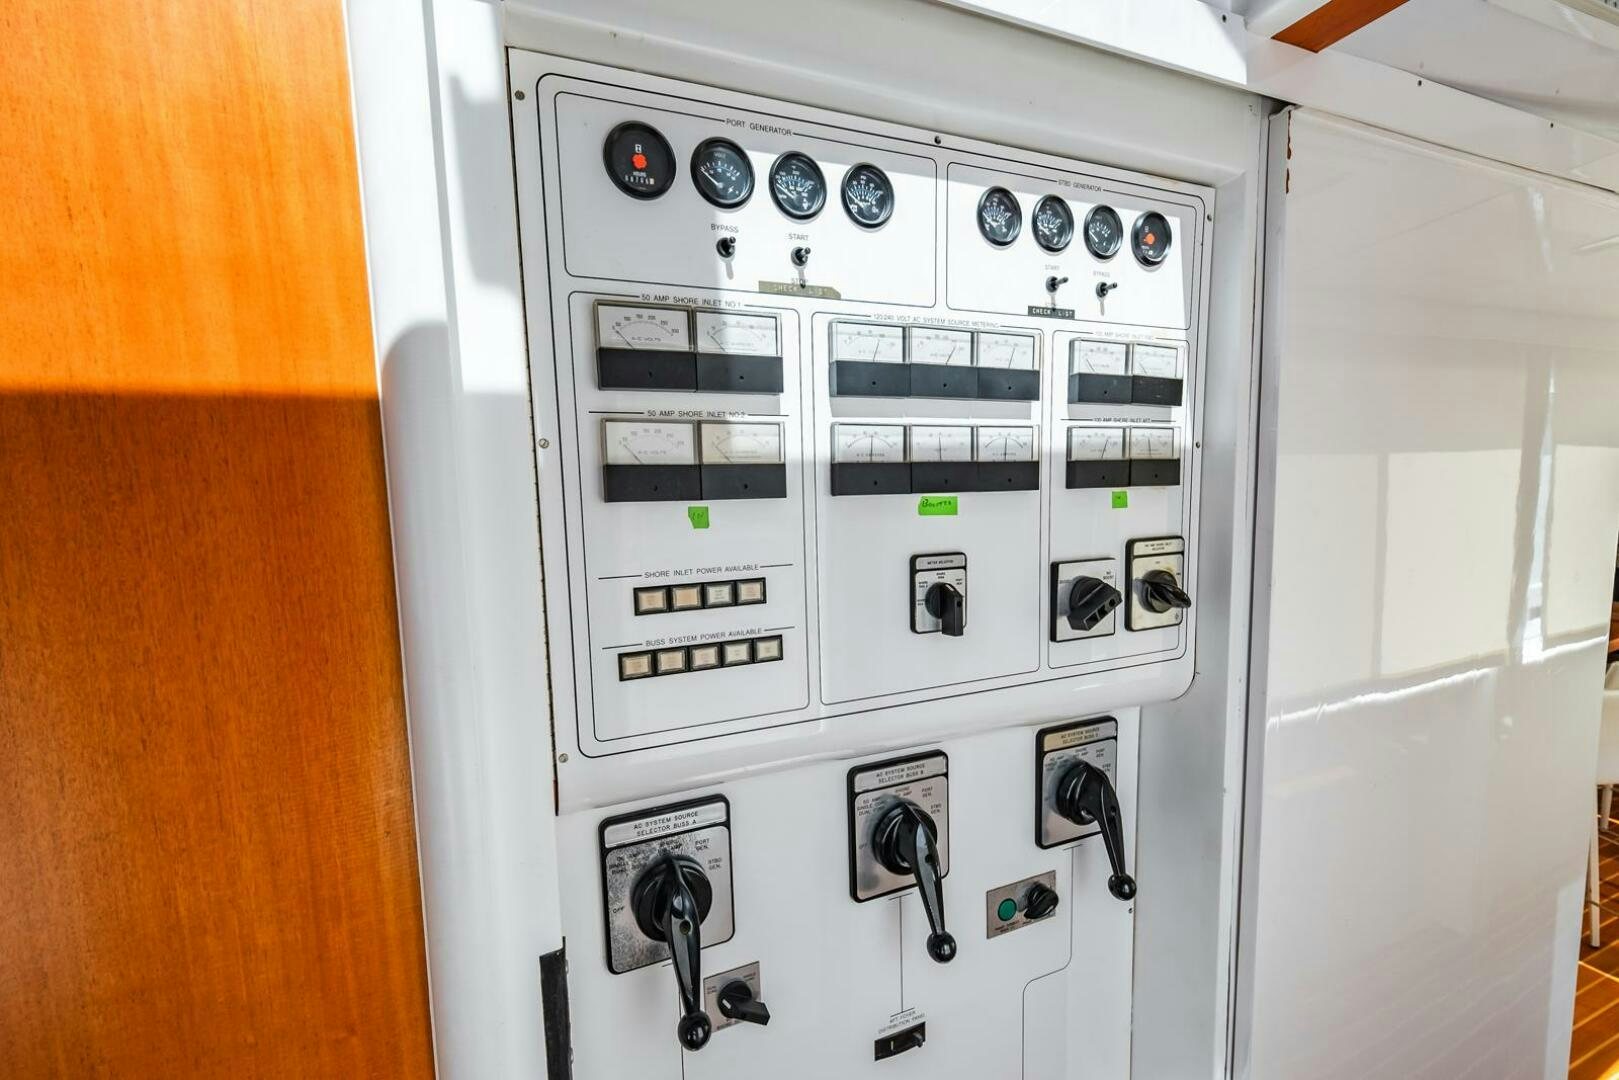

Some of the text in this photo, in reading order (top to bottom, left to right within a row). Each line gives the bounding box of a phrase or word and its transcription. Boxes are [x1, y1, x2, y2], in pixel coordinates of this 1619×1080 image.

[726, 118, 792, 136] PORT GENERATOR
[710, 223, 739, 234] BYPASS
[788, 233, 809, 241] START
[673, 296, 699, 305] SHORE
[701, 298, 721, 307] INLET
[1032, 307, 1051, 315] CHECK
[923, 317, 946, 325] SYSTEM
[678, 410, 703, 418] SHORE
[644, 564, 759, 578] SHORE INLET POWER AVAILABLE
[645, 627, 762, 648] BUSS SYSTEM POWER AVAILABLE
[645, 818, 671, 828] SYSTEM
[674, 811, 698, 821] SOURCE
[636, 825, 671, 836] SELECTOR
